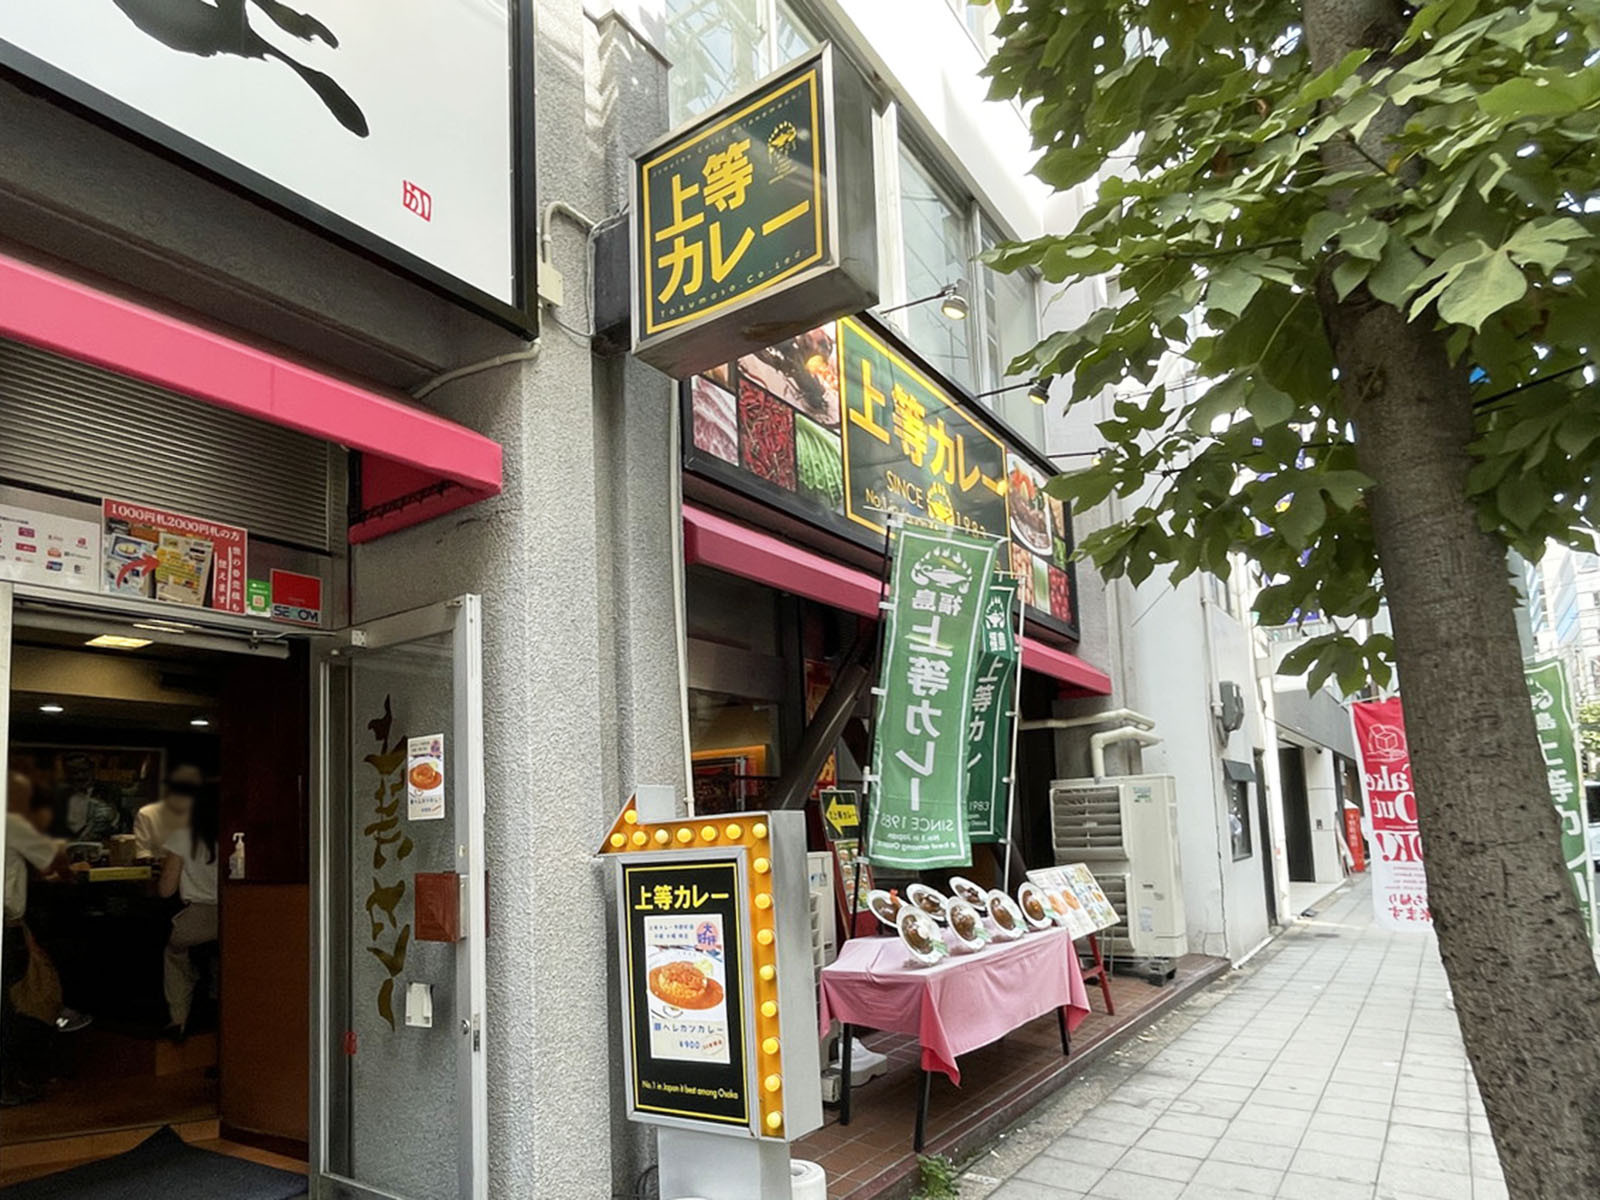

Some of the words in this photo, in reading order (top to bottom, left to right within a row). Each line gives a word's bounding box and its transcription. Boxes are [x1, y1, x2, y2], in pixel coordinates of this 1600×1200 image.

[655, 138, 753, 242] 上等
[658, 200, 809, 304] カレー
[849, 358, 1007, 496] 上等カレー
[886, 470, 925, 509] SINCE
[634, 884, 730, 911] 上等カレー
